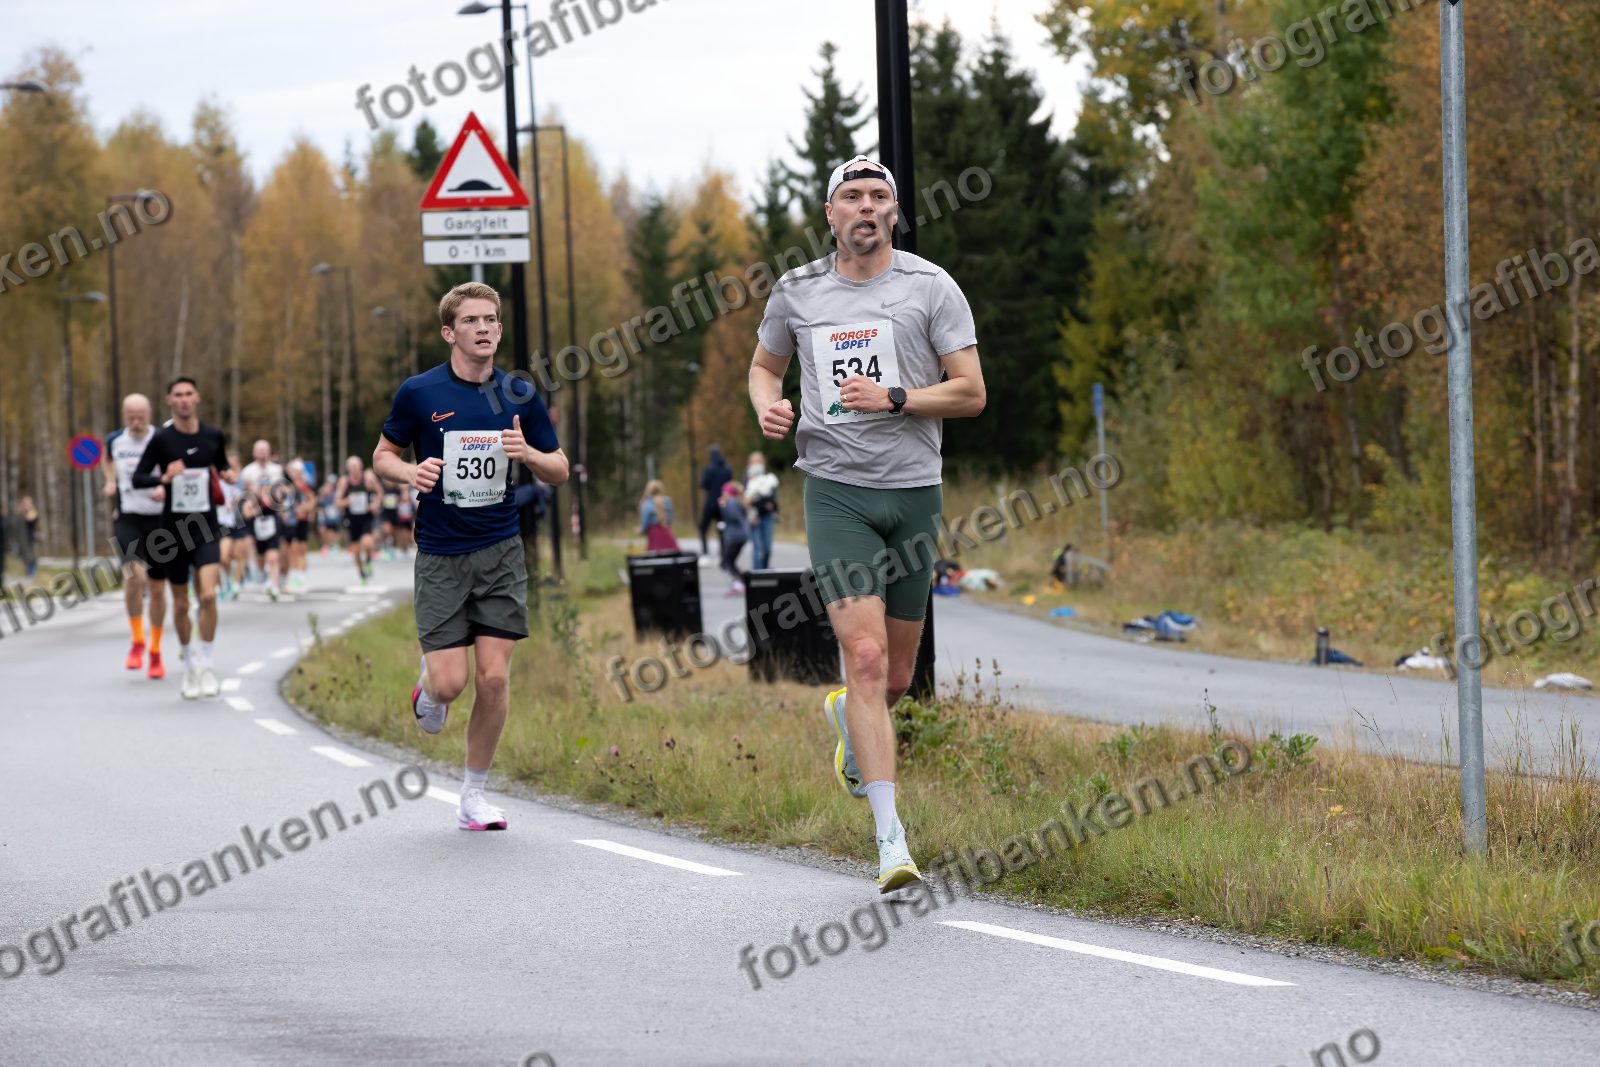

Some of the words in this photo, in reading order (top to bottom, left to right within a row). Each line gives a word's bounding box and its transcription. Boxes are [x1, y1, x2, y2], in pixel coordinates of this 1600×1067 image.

[444, 216, 508, 231] Gangfelt
[448, 245, 459, 259] 0
[829, 328, 879, 342] NORGES
[835, 338, 872, 351] LØPET
[460, 436, 499, 444] NORGES
[462, 443, 492, 451] LØPET
[456, 456, 496, 480] 530
[183, 483, 199, 497] 20
